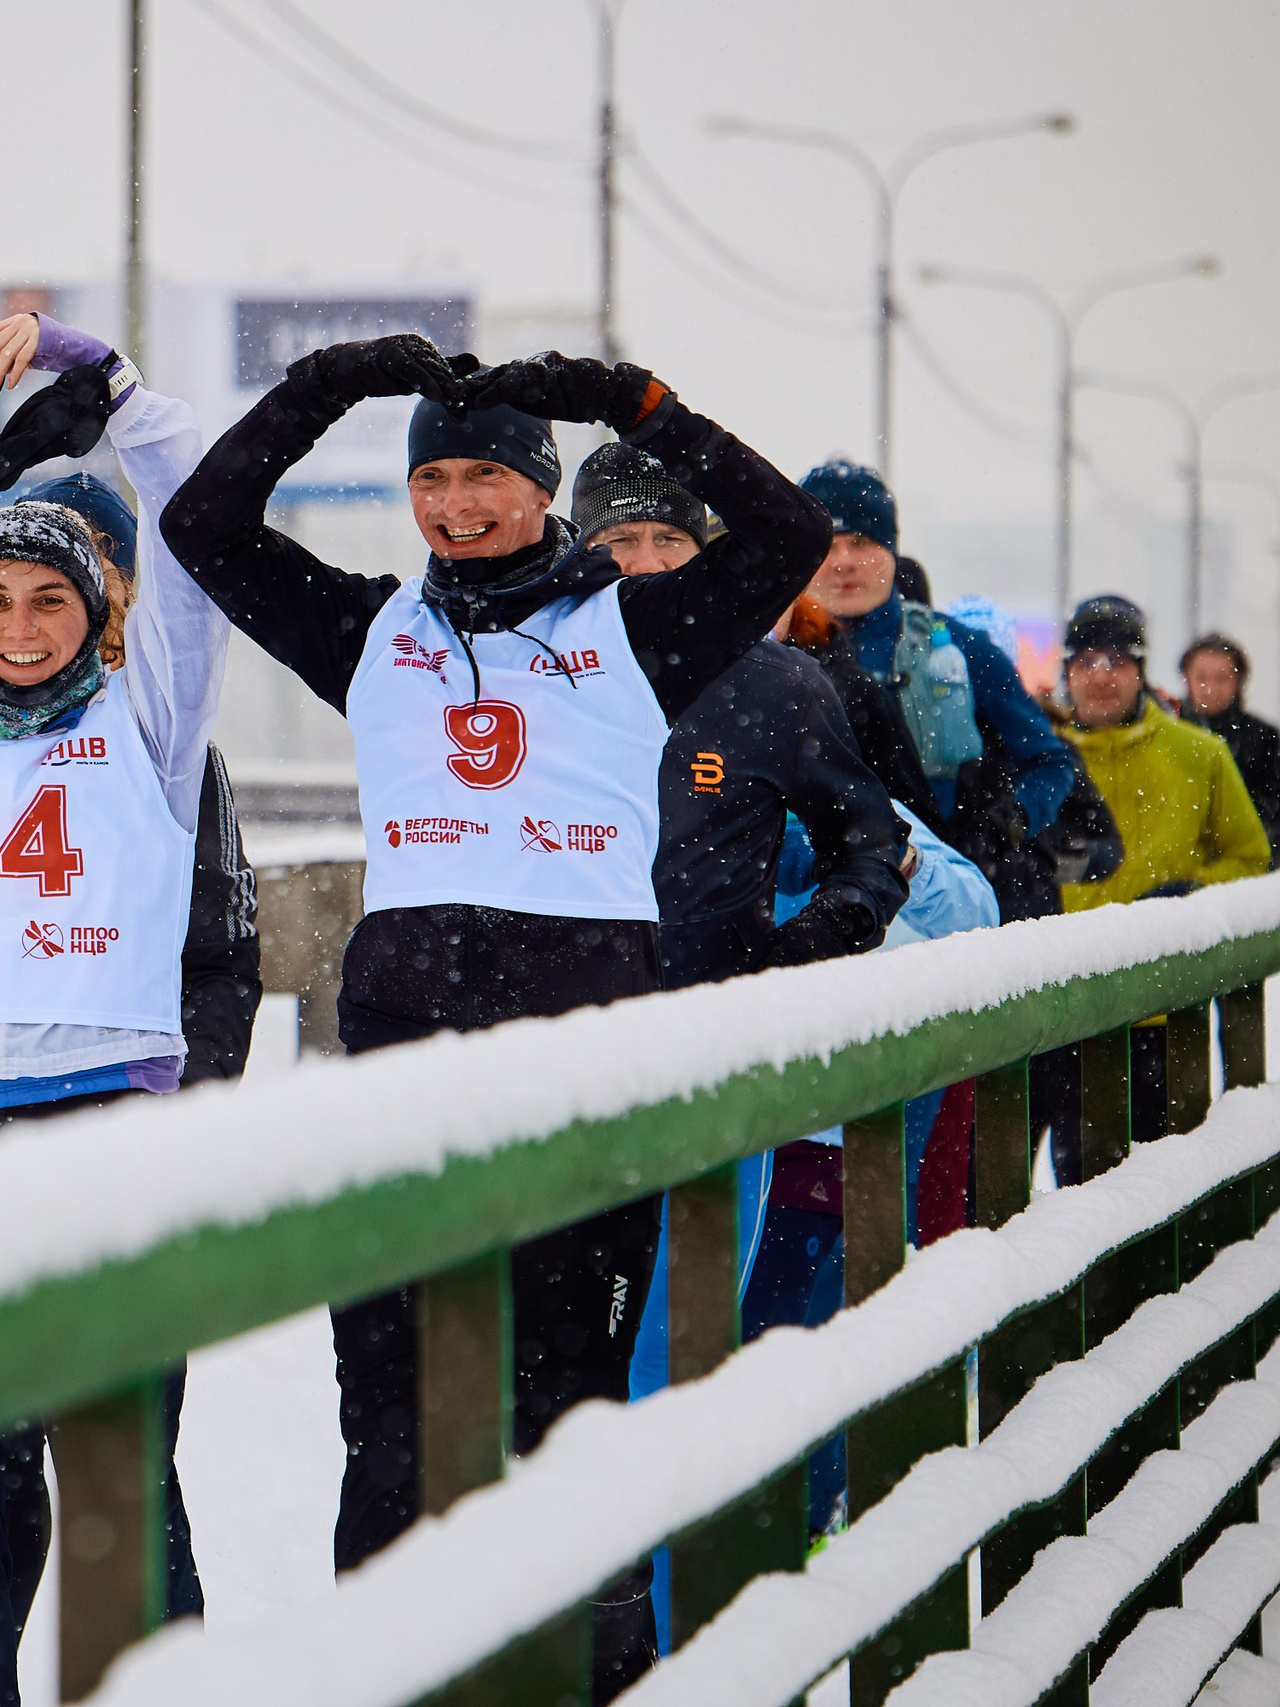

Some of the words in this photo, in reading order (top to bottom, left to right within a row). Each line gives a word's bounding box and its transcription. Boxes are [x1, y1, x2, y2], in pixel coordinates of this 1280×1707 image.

[443, 699, 528, 790] 9
[404, 817, 490, 835] ВЕРТОЛЕТЫ
[567, 824, 619, 839] ППОО
[404, 831, 462, 845] РОССИИ
[567, 838, 606, 855] НЦВ
[70, 927, 120, 942] ППОО
[70, 940, 108, 956] НЦВ
